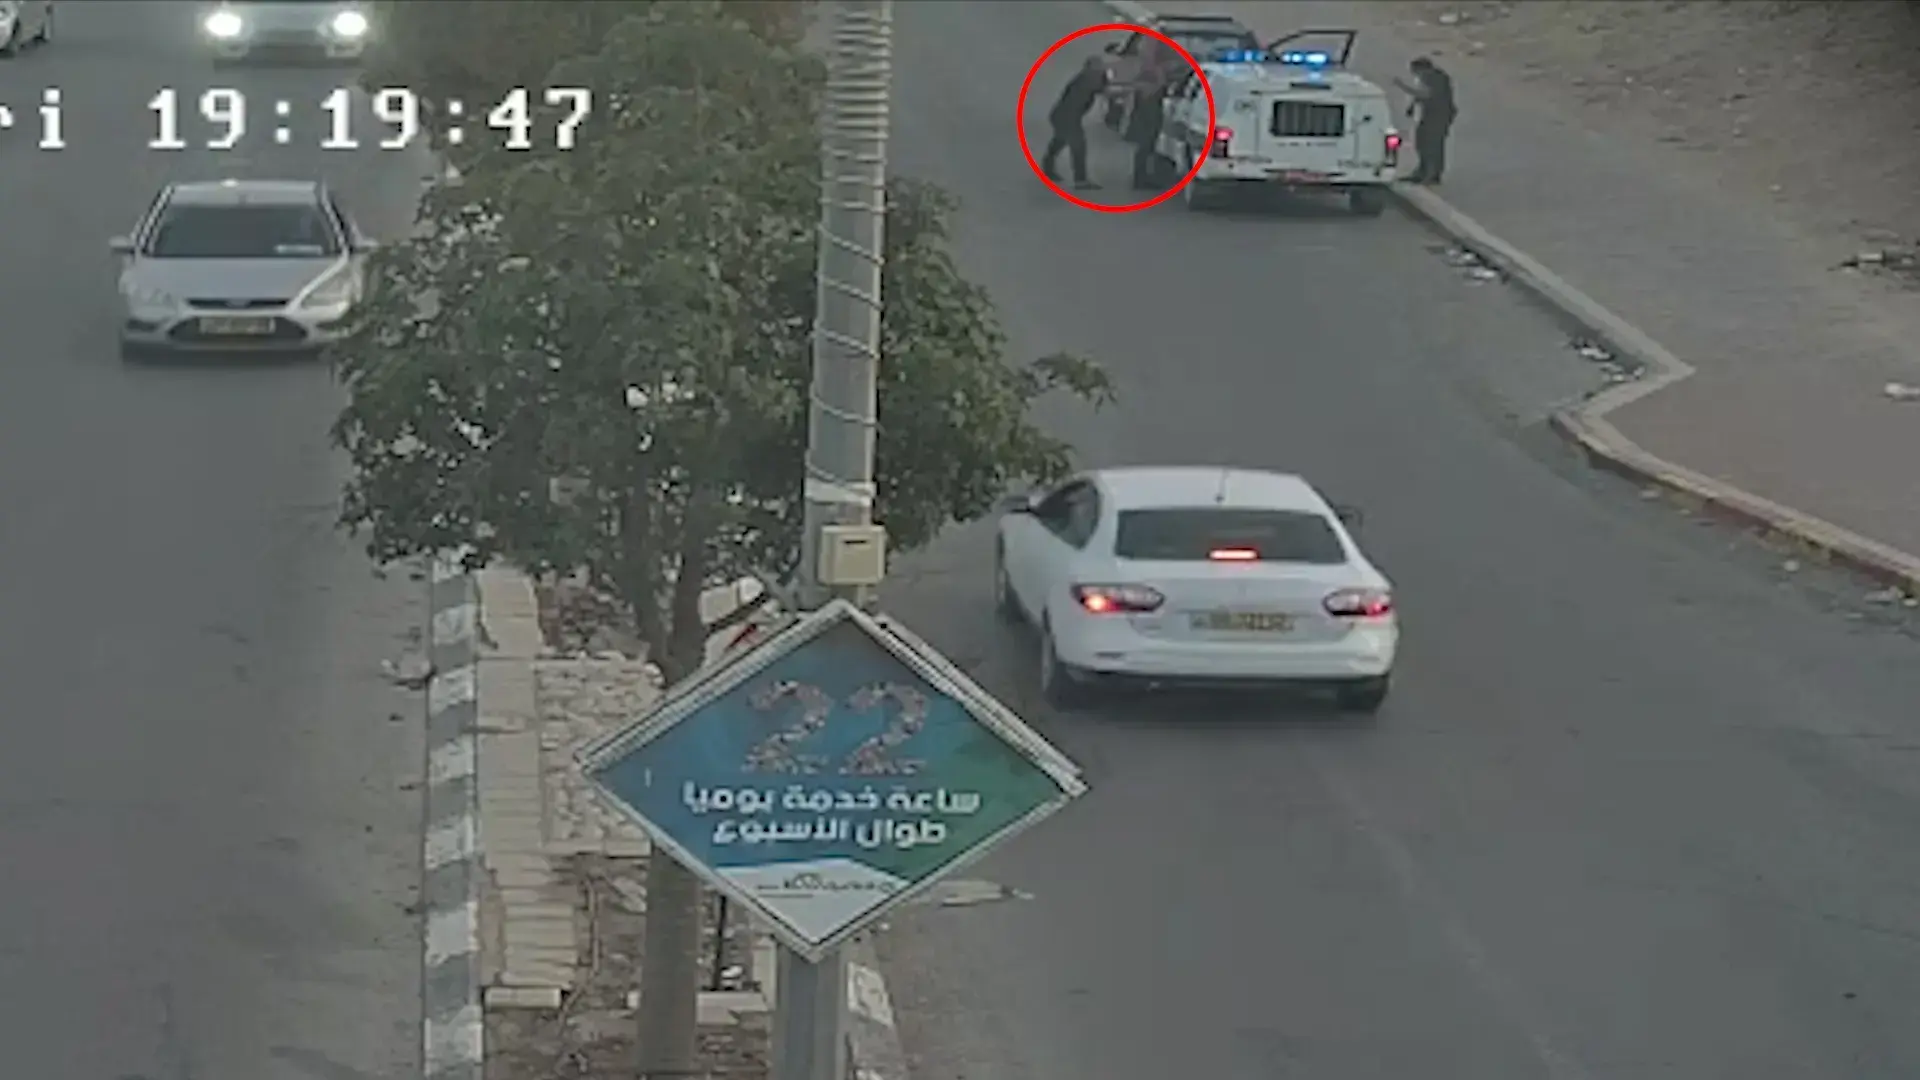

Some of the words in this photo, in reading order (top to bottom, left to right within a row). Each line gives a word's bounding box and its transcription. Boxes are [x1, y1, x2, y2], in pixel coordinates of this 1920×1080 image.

[742, 681, 931, 775] 22
[782, 784, 877, 814] خدمة
[886, 787, 981, 813] ساعة
[855, 816, 947, 849] طوال
